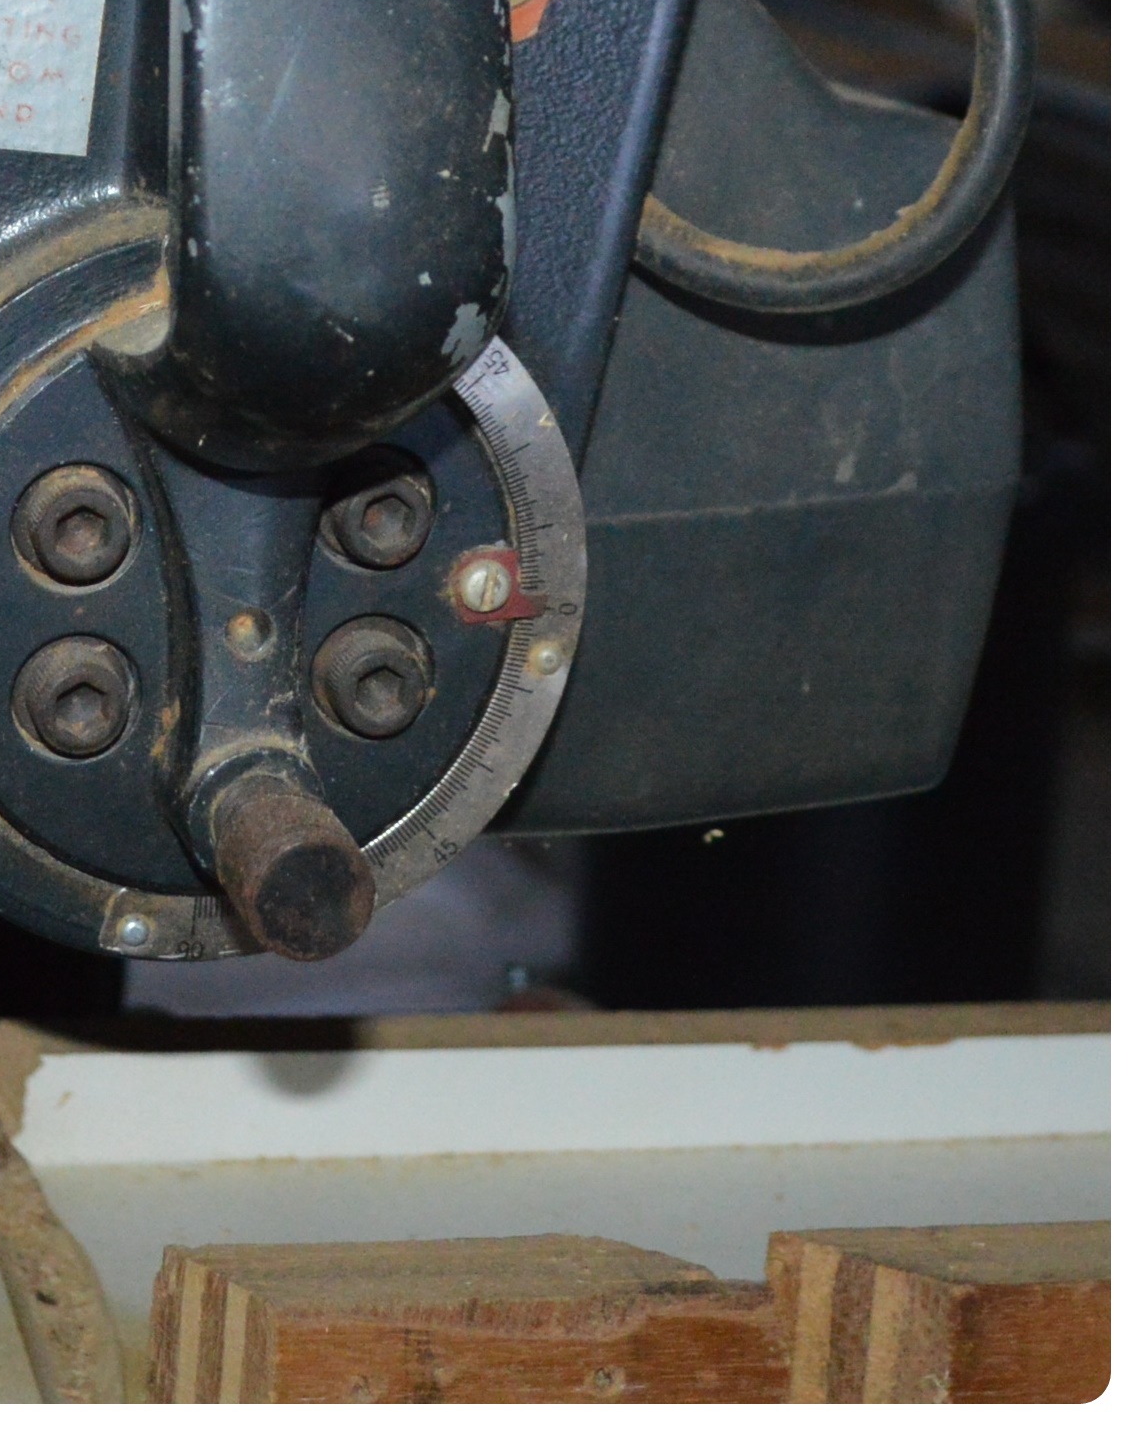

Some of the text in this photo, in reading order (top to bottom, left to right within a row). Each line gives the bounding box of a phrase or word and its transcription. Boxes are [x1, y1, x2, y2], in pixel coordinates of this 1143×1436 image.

[483, 350, 509, 375] 45
[559, 603, 577, 616] 0
[433, 838, 458, 864] 45
